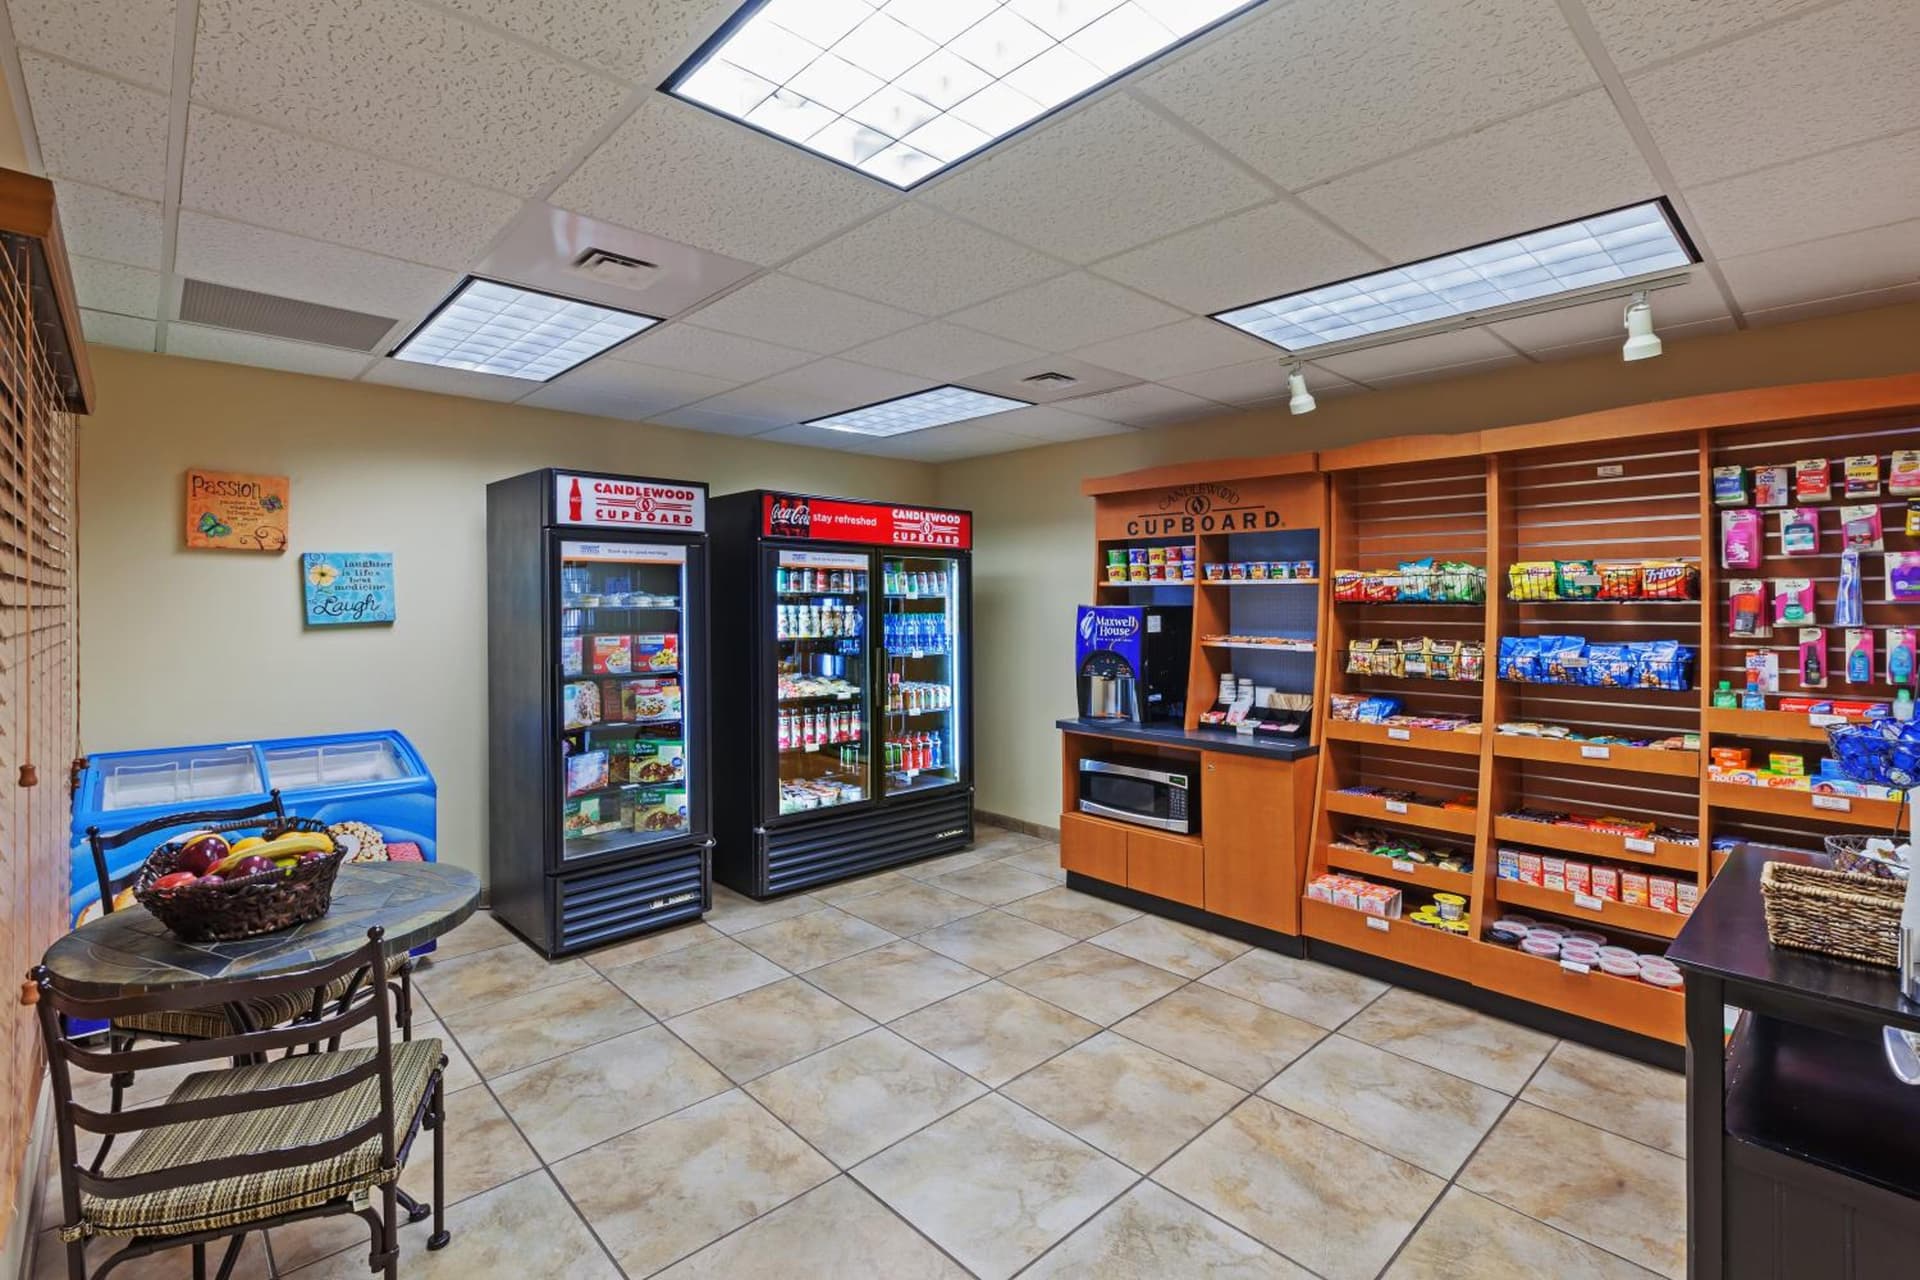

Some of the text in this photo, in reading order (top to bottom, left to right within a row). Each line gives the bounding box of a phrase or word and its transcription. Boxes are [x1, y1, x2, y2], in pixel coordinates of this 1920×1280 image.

[192, 475, 261, 499] Passion
[594, 482, 694, 501] CANDLEWOOD
[1158, 483, 1240, 511] CANDLEWOOD
[595, 509, 693, 524] CUPBOARD
[813, 514, 878, 527] stay refreshed
[892, 508, 960, 525] CANDLEWOOD
[1127, 511, 1280, 536] CUPBOARD
[893, 531, 960, 544] CUPBOARD
[1648, 567, 1681, 584] Fritos
[313, 593, 380, 620] Laugh
[1096, 615, 1135, 628] Maxwell
[1100, 627, 1130, 636] House
